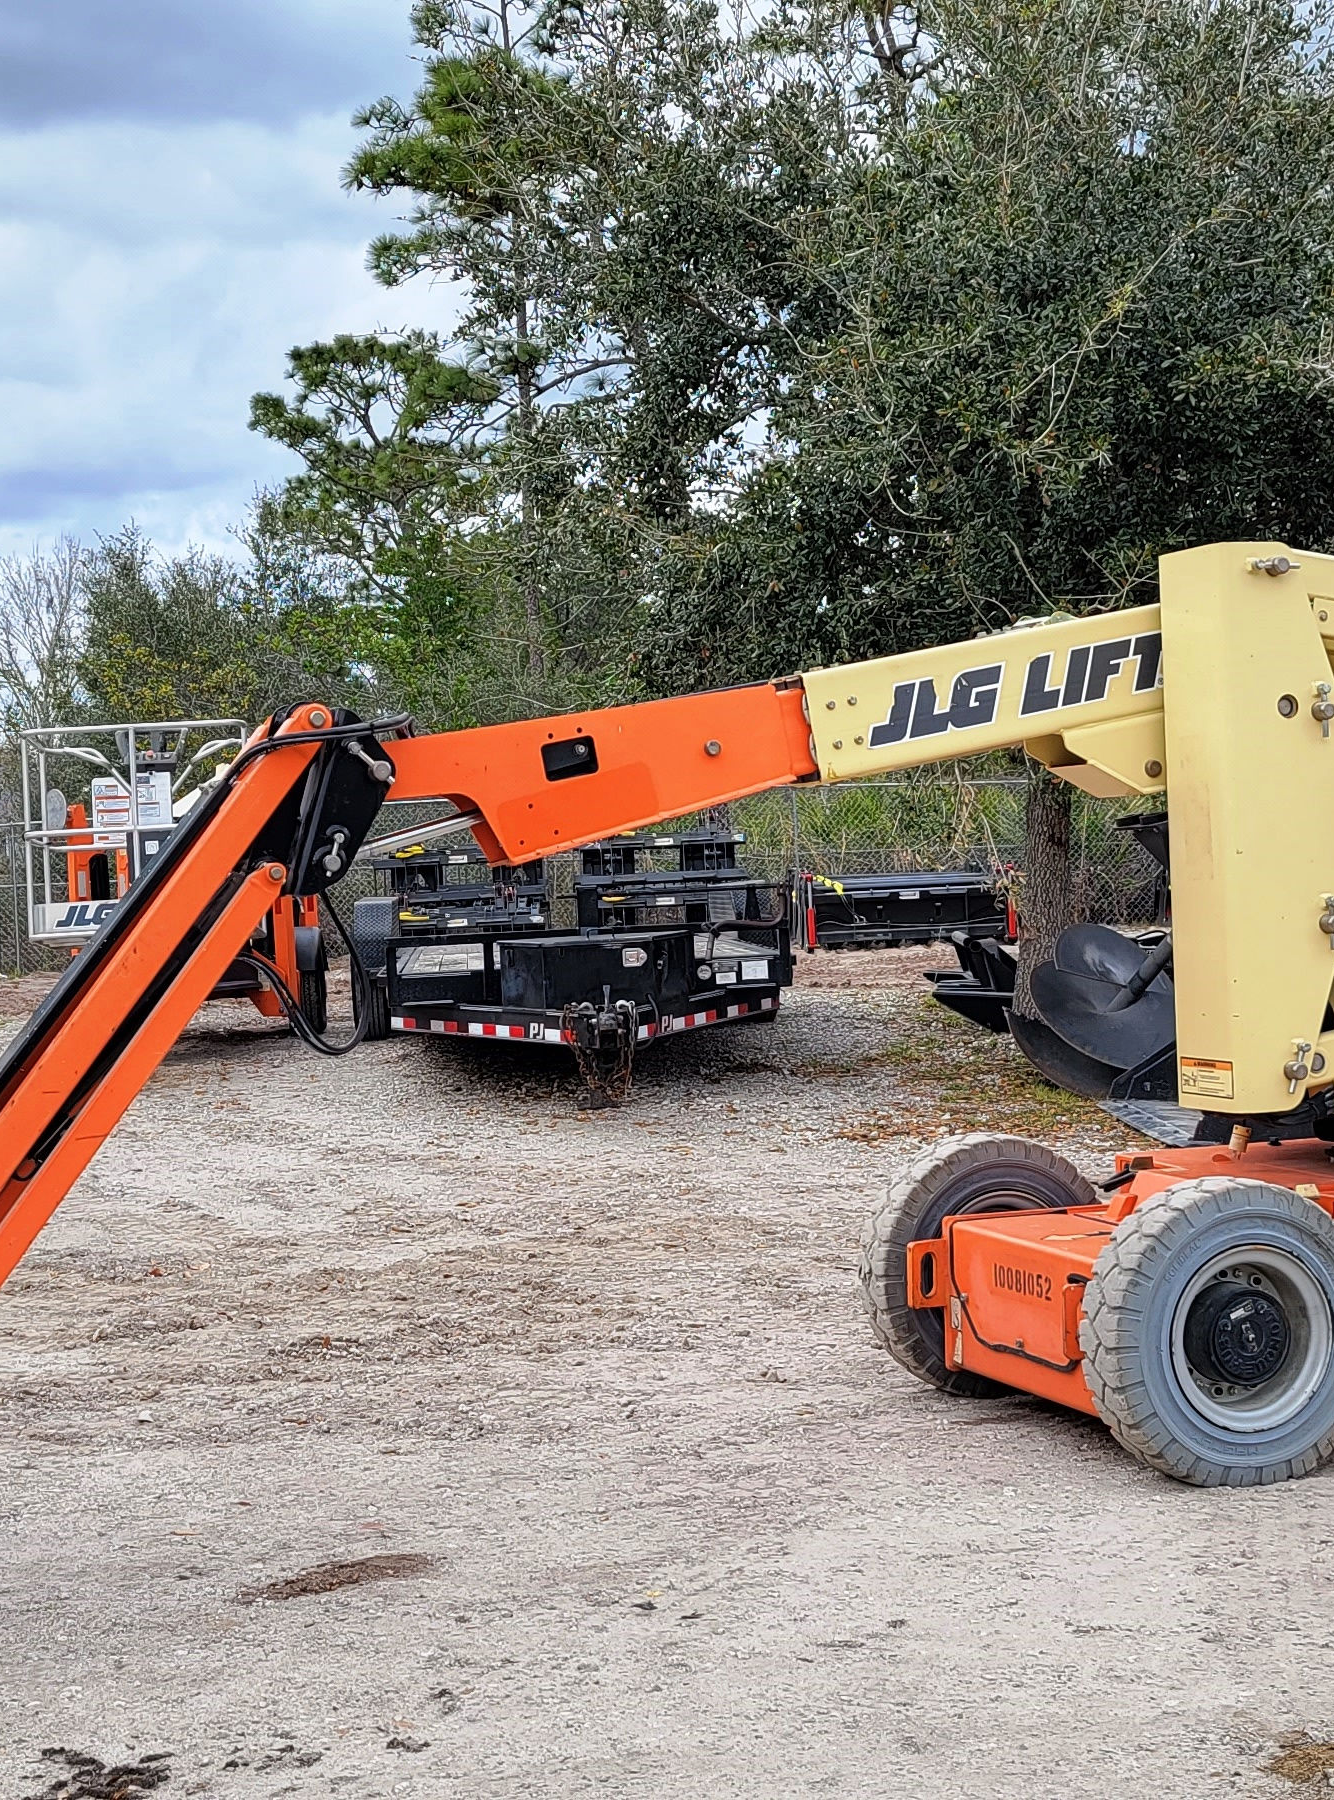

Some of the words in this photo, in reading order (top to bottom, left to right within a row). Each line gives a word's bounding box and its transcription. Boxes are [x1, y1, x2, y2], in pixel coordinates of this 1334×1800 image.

[869, 664, 1004, 748] JLG
[1020, 632, 1162, 716] LIFT
[529, 1022, 545, 1039] PJ
[661, 1015, 674, 1034] PJ
[993, 1262, 1053, 1302] 10081052
